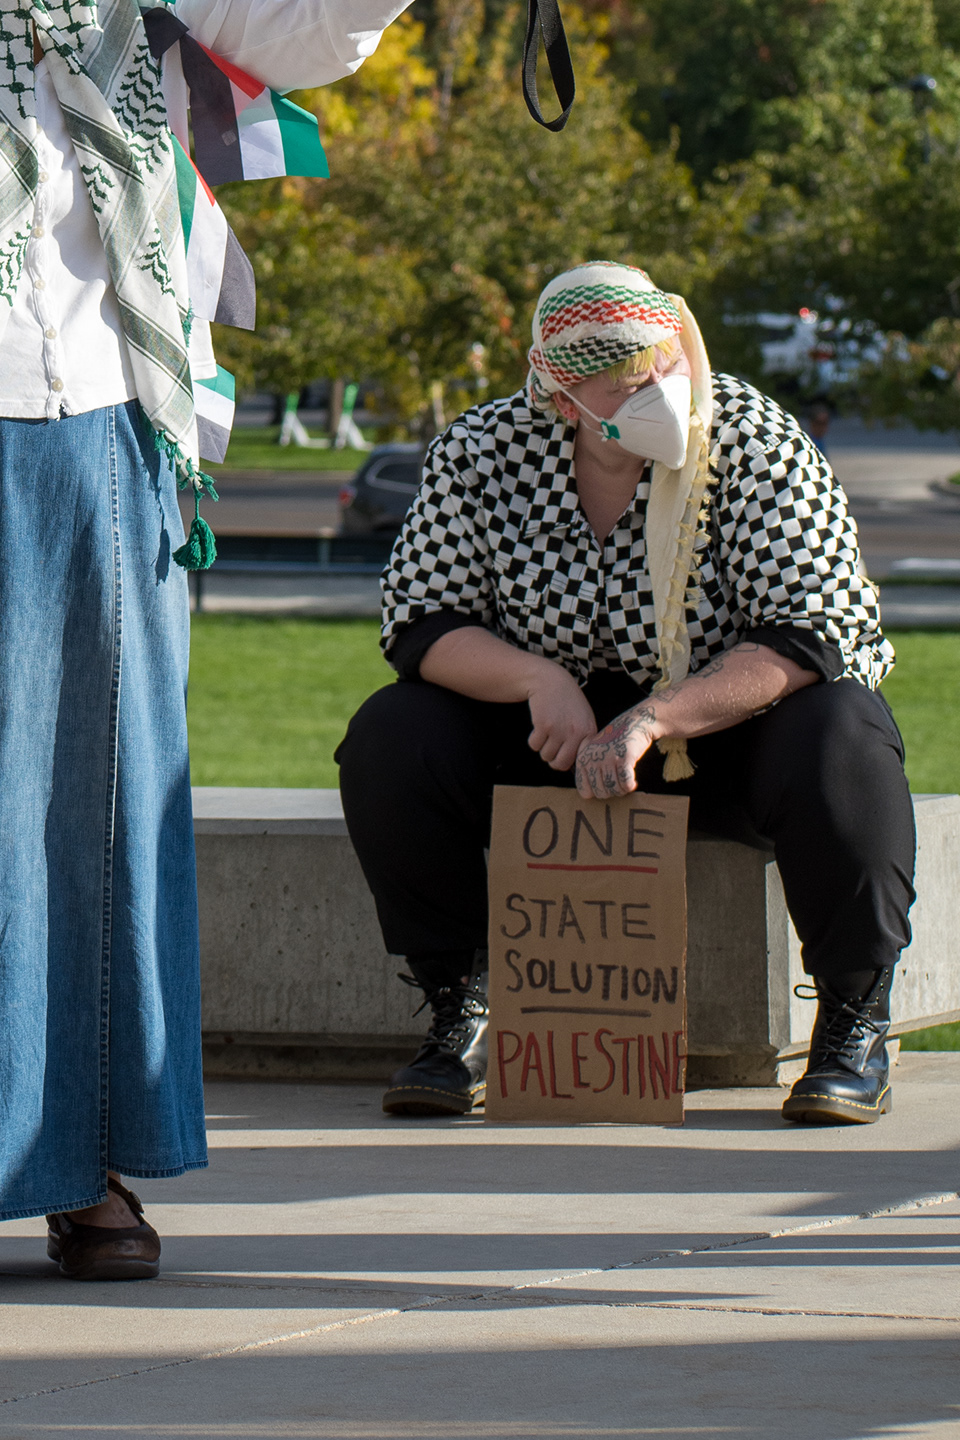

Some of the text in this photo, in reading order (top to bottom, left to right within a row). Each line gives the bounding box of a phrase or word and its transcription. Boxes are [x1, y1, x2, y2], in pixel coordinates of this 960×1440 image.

[522, 804, 666, 861] ONE
[500, 893, 657, 943] STATE
[505, 949, 679, 1004] SOLUTION
[497, 1028, 688, 1100] PALESTINE
